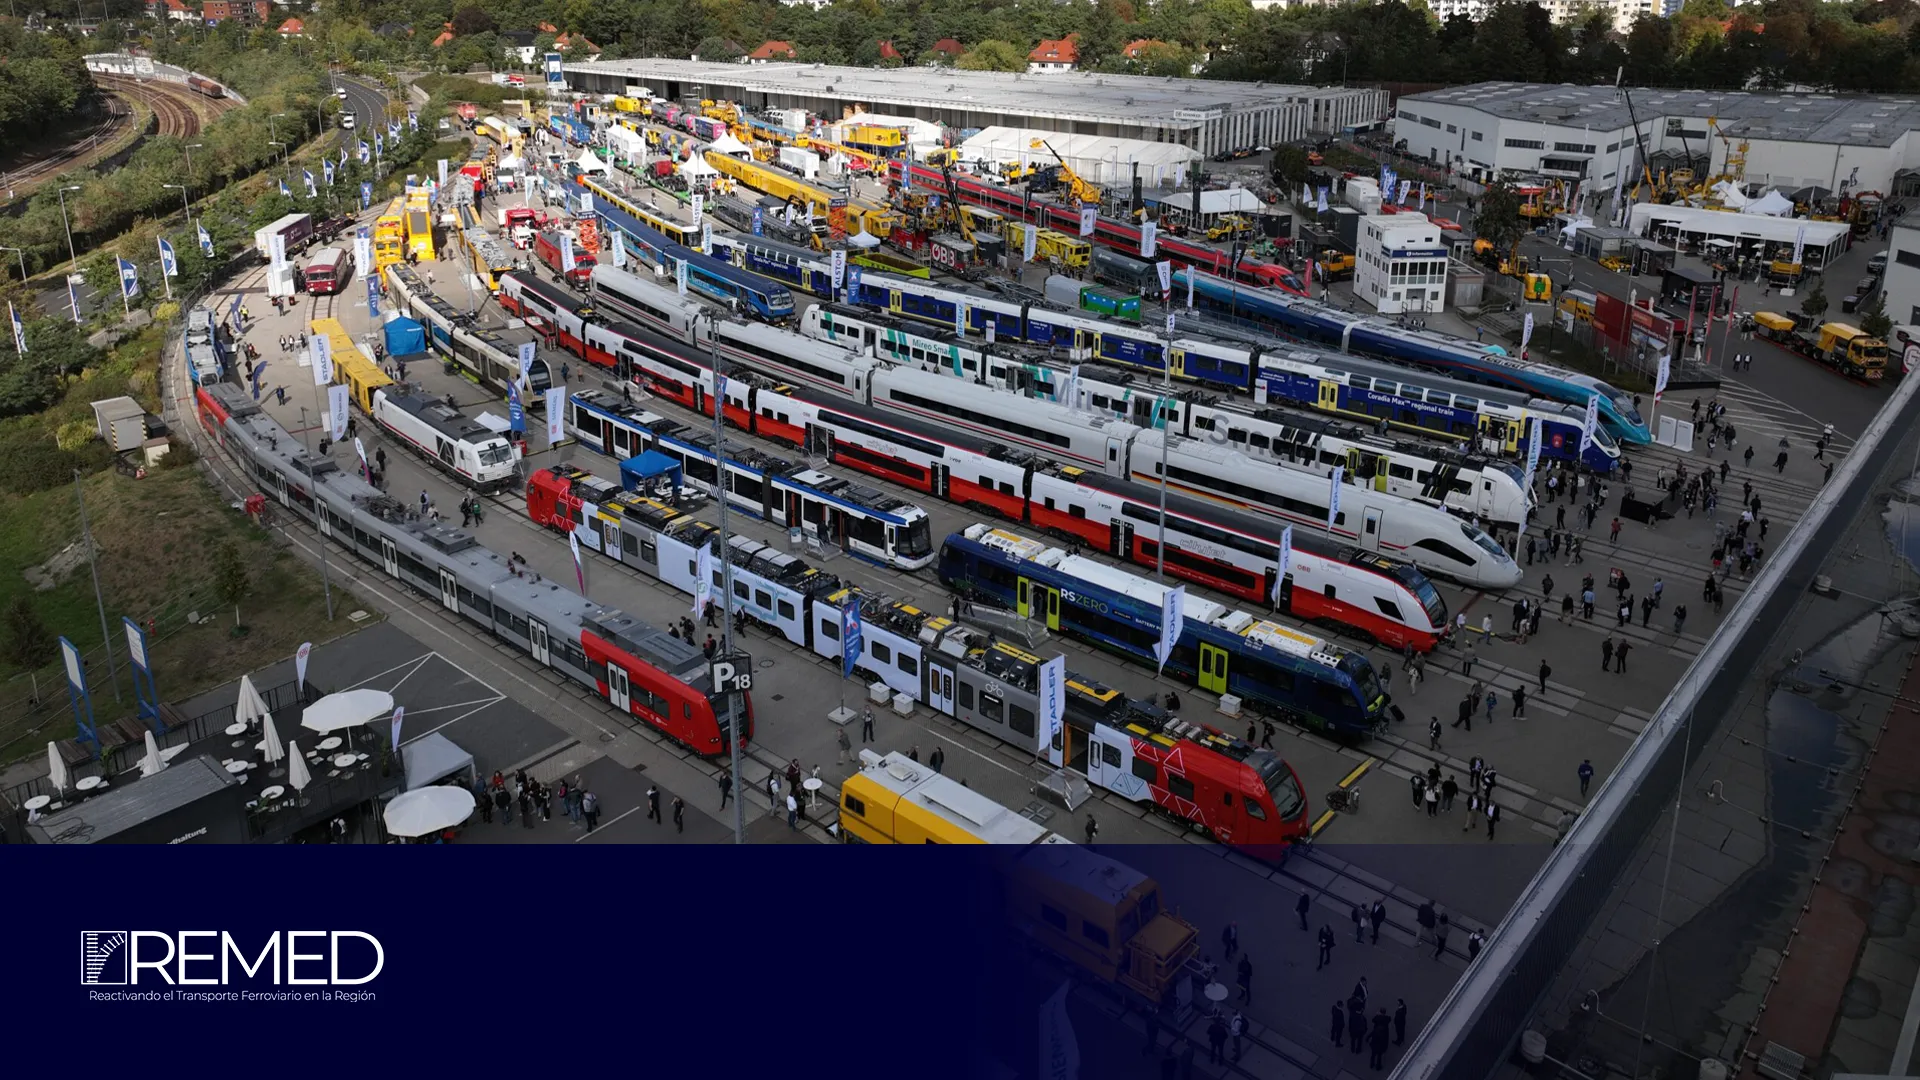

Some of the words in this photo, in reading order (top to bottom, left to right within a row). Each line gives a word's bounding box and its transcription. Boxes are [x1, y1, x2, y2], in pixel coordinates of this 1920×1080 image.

[834, 252, 842, 286] ALSTOM
[912, 339, 932, 351] Mireo
[317, 338, 329, 381] STADLER
[1367, 392, 1390, 403] Coradia
[1410, 401, 1437, 412] regional
[1438, 407, 1454, 417] train
[1583, 399, 1596, 446] ALSTOM
[1529, 424, 1538, 470] SIEMENS
[1180, 537, 1226, 560] cityjet
[1060, 588, 1109, 614] RSZERO
[1135, 618, 1156, 629] BATTERY
[168, 826, 208, 845] dhaltung
